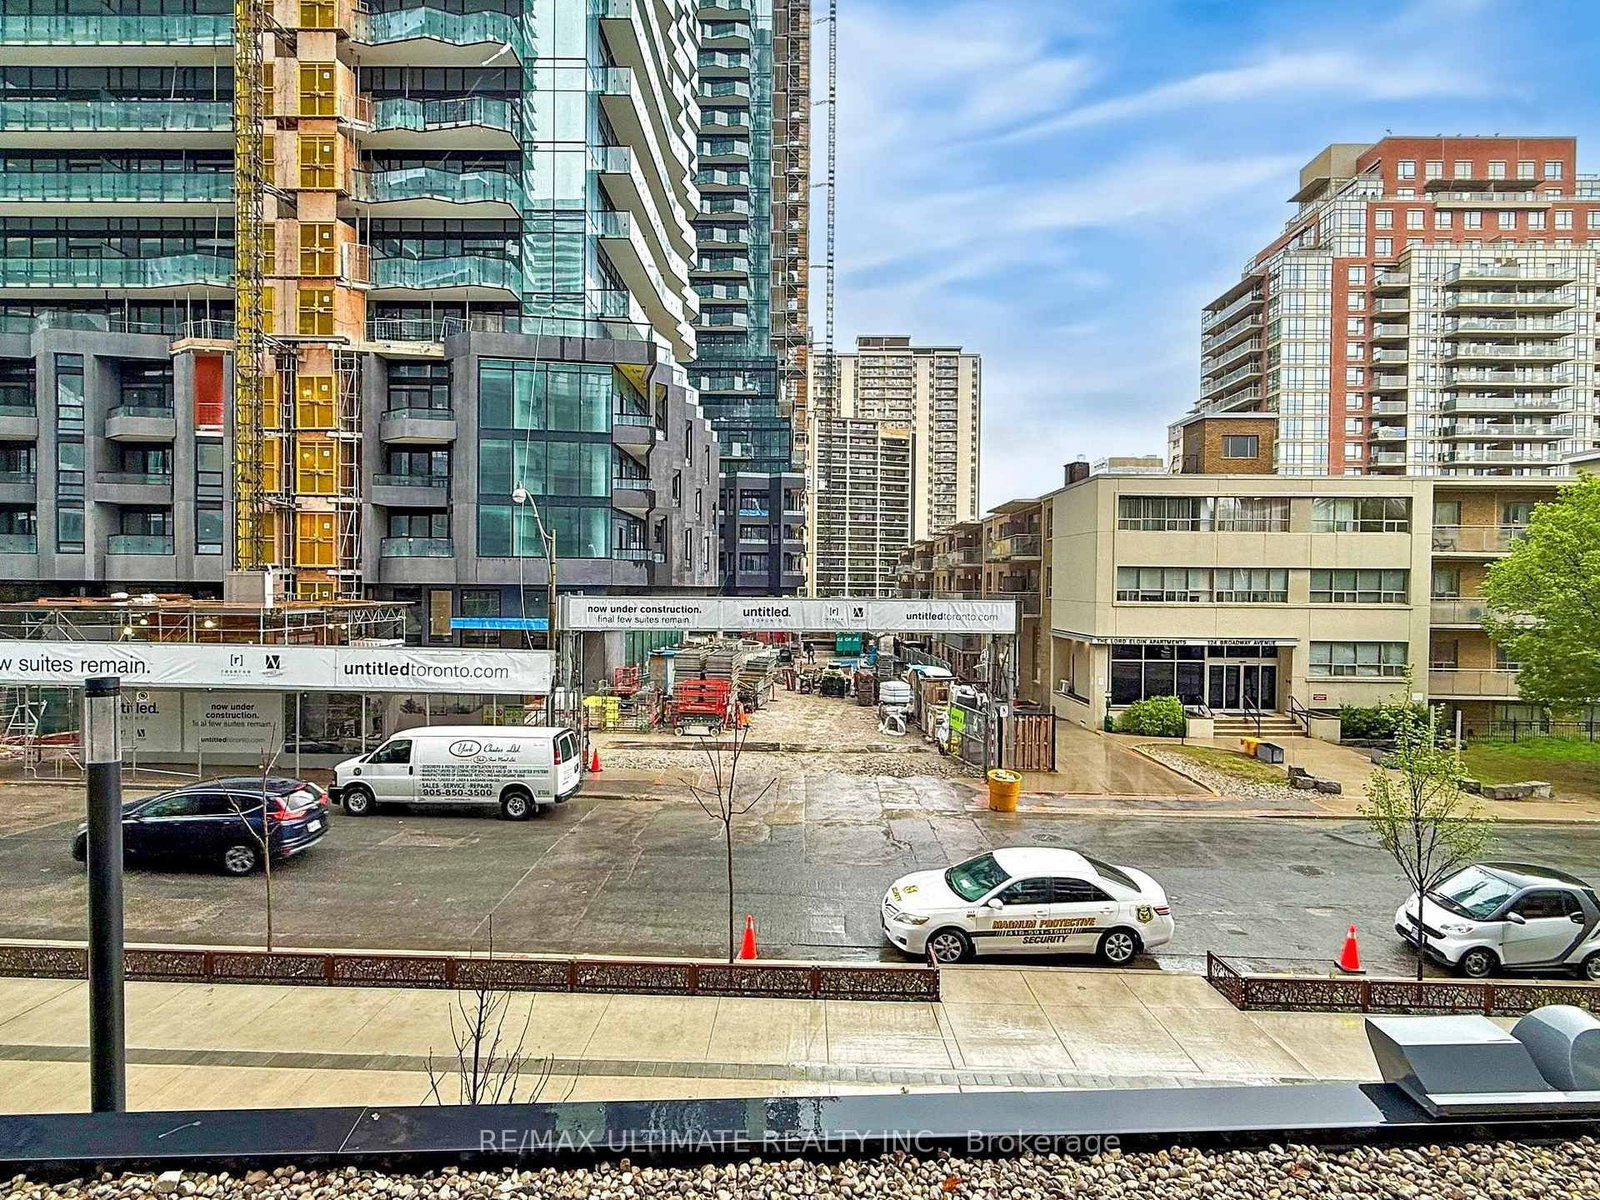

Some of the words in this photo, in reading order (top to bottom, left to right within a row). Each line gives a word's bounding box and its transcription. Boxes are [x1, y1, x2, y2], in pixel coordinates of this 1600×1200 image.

[587, 605, 608, 614] now
[610, 604, 637, 614] under
[639, 604, 702, 614] construction.
[742, 606, 791, 617] untitled.
[597, 615, 614, 623] final
[617, 615, 633, 624] few
[634, 615, 659, 624] suites
[906, 612, 998, 621] untitledtoronto.com
[18, 653, 73, 673] suites
[80, 655, 151, 675] remain.
[343, 662, 509, 679] untitledtoronto.com
[210, 703, 229, 711] now
[230, 702, 255, 711] under
[205, 711, 260, 720] construction.
[457, 742, 474, 755] York
[422, 788, 493, 797] 905-850-3500
[991, 919, 1037, 930] MAGNUM
[1039, 917, 1096, 928] PROTECTIVE
[1022, 935, 1069, 944] SECURITY
